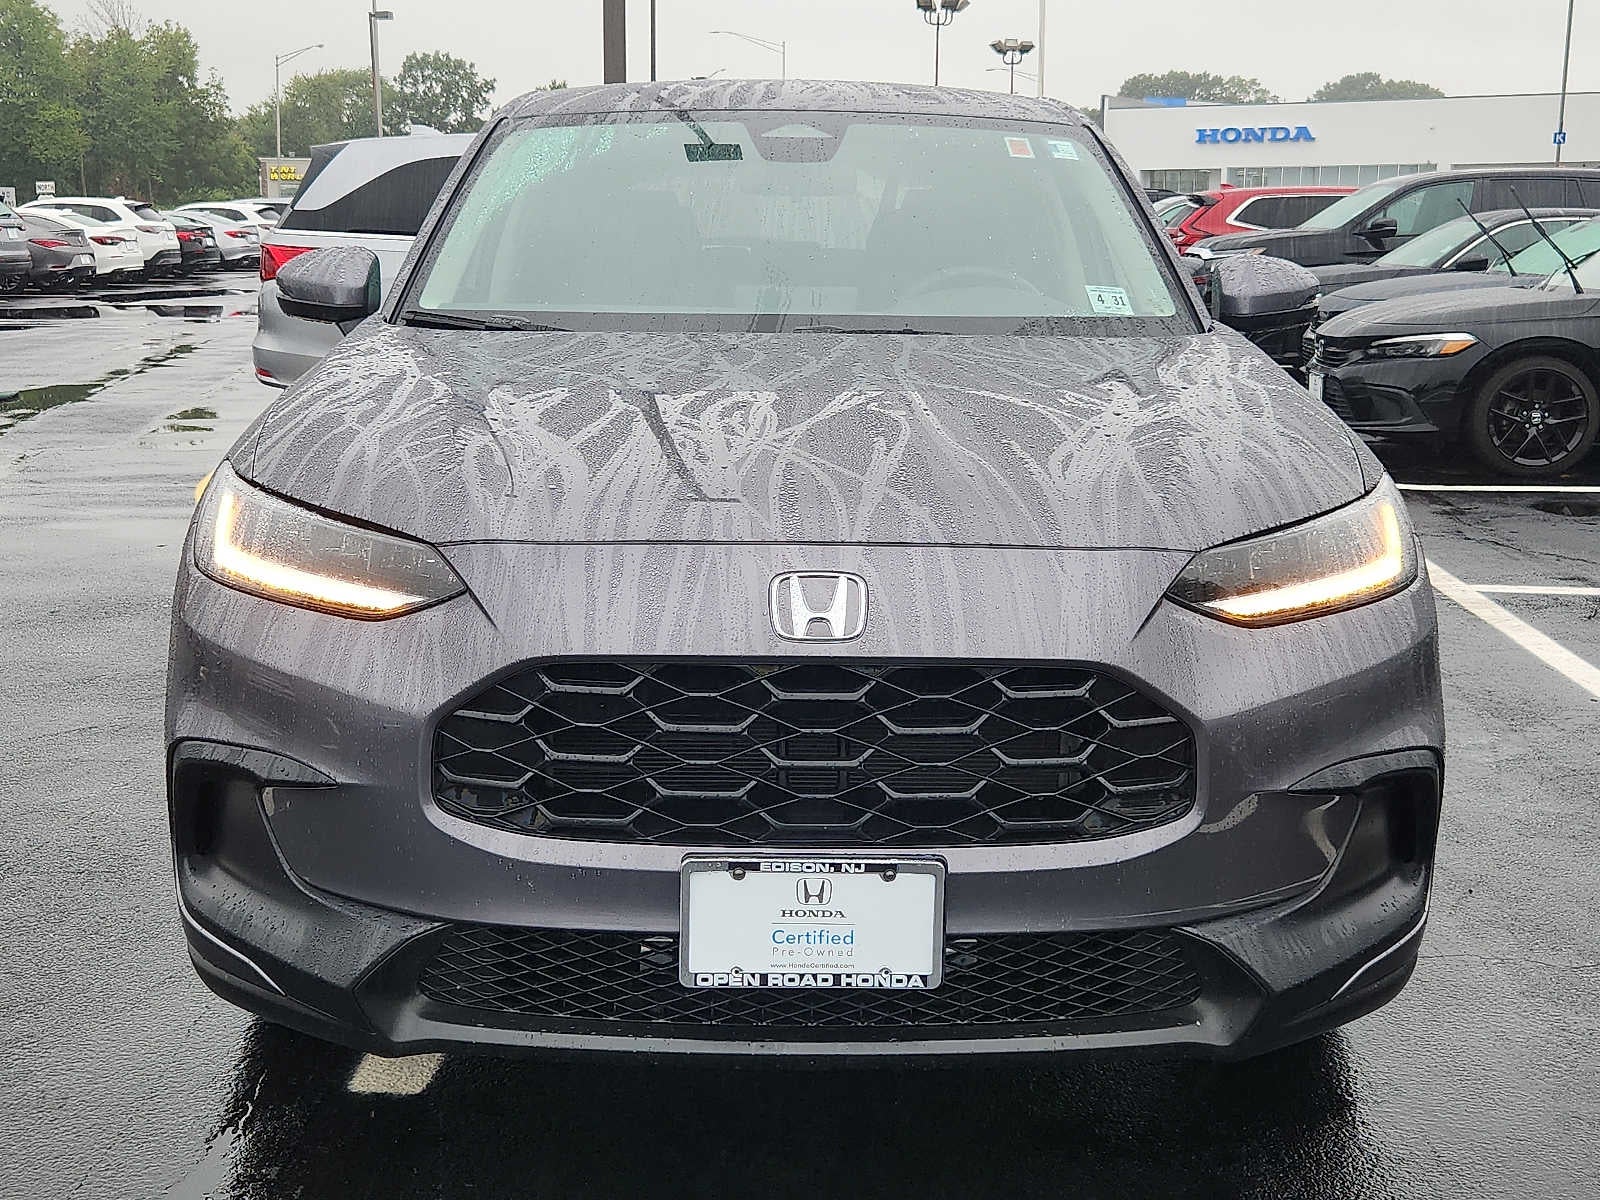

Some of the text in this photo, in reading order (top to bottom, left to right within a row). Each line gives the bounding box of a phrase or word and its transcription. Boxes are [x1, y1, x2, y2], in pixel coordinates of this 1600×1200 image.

[1195, 126, 1316, 144] HONDA
[1097, 294, 1126, 306] 4 31
[841, 862, 866, 873] NJ
[780, 909, 847, 918] HONDA
[772, 929, 854, 945] Certified
[772, 947, 854, 957] Pre-Owned
[696, 973, 924, 988] OPEN ROAD HONDA
